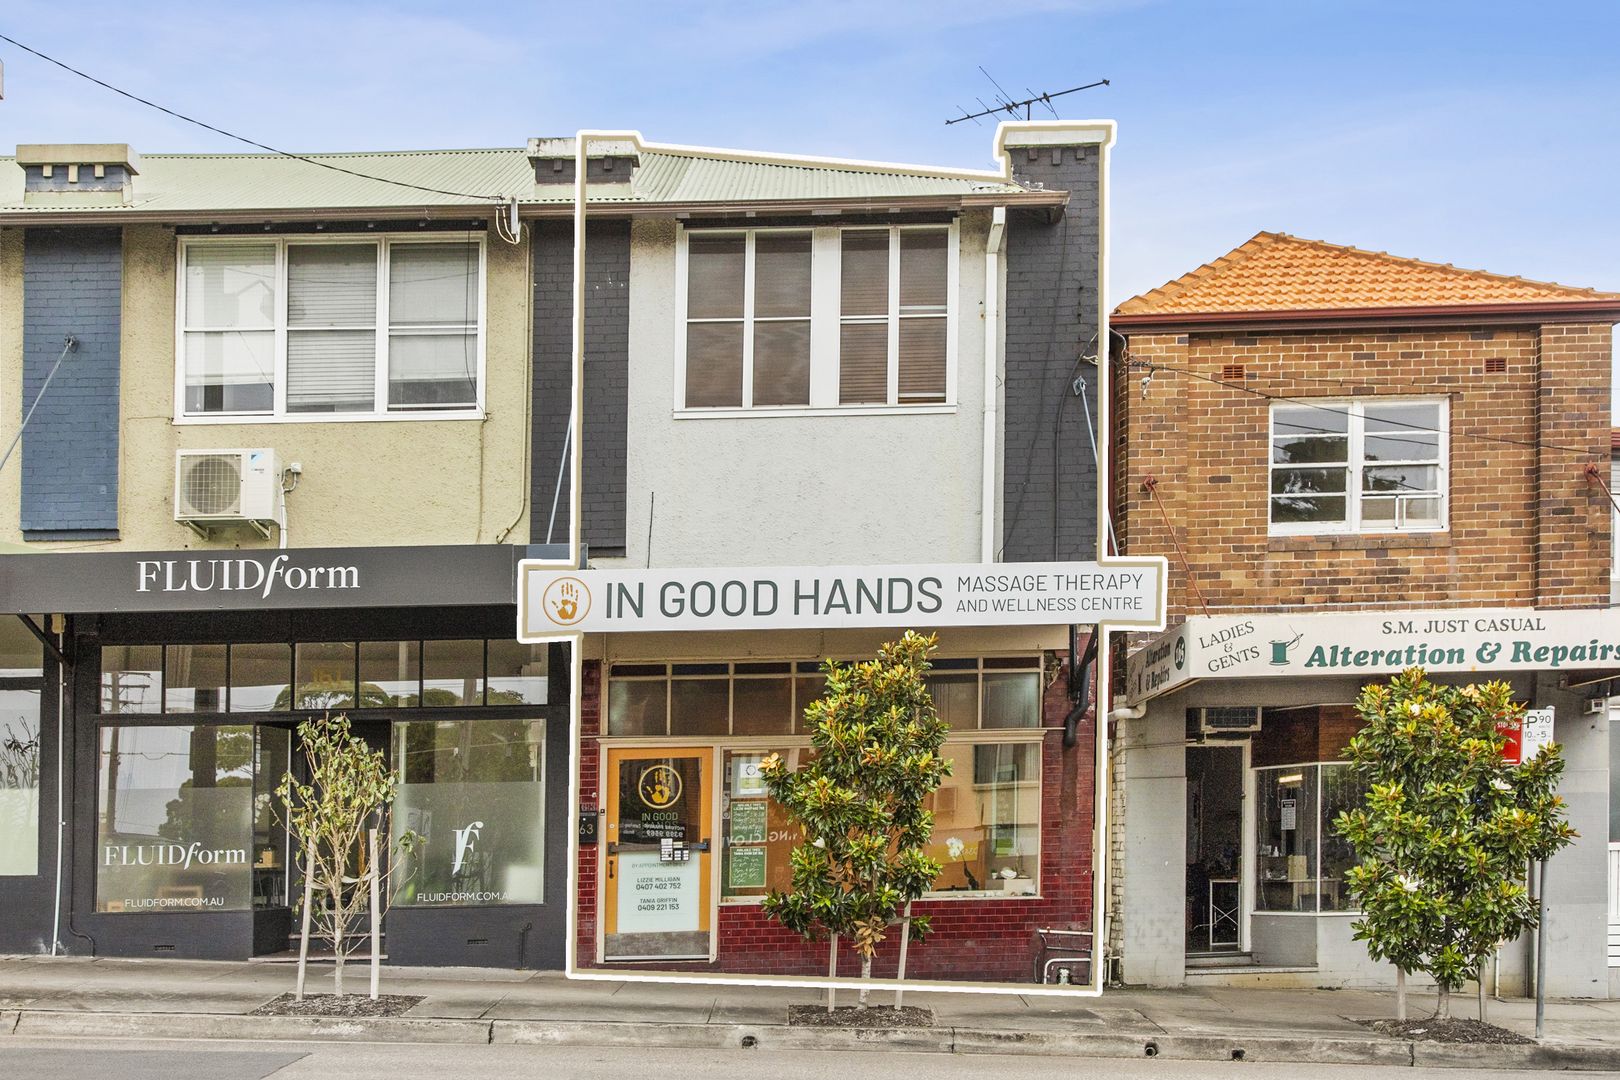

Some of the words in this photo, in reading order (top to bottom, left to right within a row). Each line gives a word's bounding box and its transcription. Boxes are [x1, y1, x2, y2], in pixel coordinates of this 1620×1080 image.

[957, 574, 1048, 593] MASSAGE
[1053, 573, 1144, 592] THERAPY
[605, 582, 644, 619] IN
[659, 579, 779, 618] GOOD
[793, 576, 943, 616] HANDS
[956, 598, 988, 613] AND
[992, 597, 1077, 612] WELLNESS
[1081, 596, 1143, 611] CENTRE
[1382, 620, 1419, 635] S.M.
[1423, 618, 1470, 635] JUST
[1474, 617, 1547, 633] CASUAL
[1199, 621, 1256, 650] LADIES
[1223, 642, 1234, 653] &
[1304, 642, 1466, 668] Alteration
[1475, 641, 1502, 664] &
[1207, 645, 1261, 673] GENTS
[1526, 716, 1538, 729] P
[1539, 715, 1552, 724] 90
[641, 813, 651, 821] IN
[652, 812, 679, 821] GOOD
[124, 897, 224, 908] FLUIDFORM.COM.AU
[417, 891, 518, 902] FLUIDFORM.COM.A
